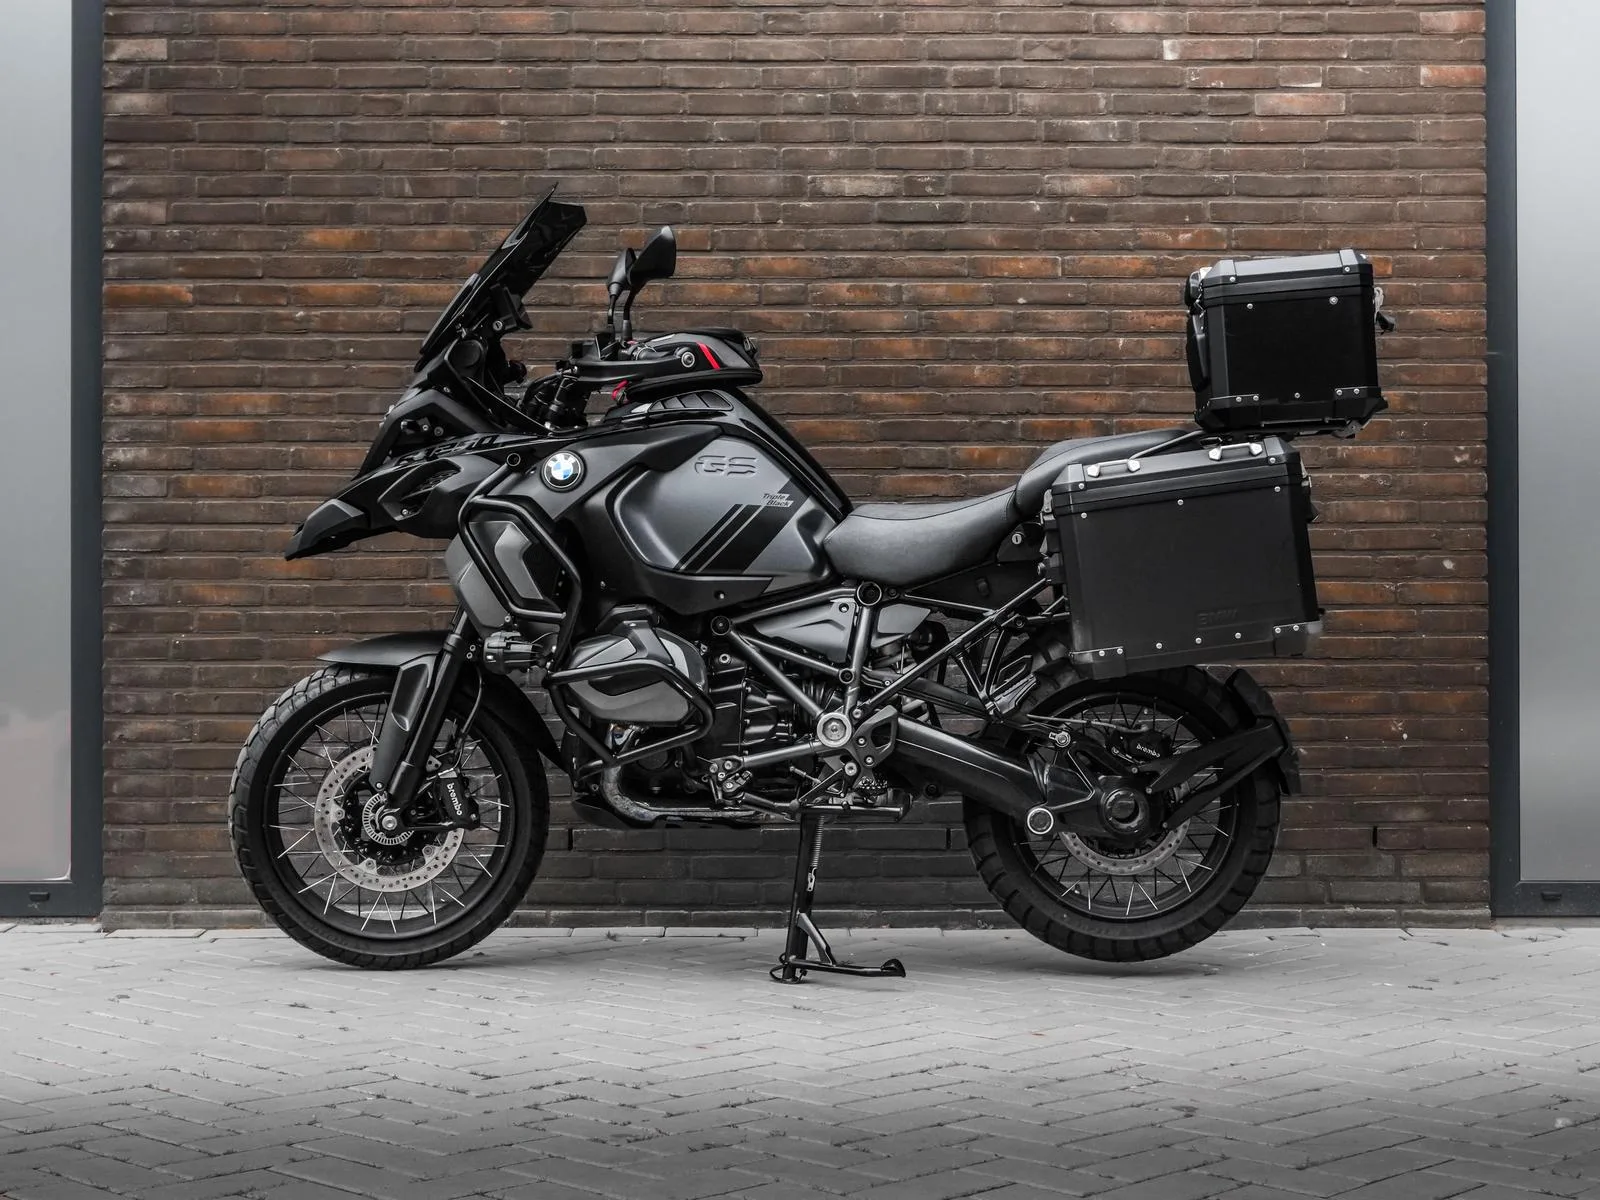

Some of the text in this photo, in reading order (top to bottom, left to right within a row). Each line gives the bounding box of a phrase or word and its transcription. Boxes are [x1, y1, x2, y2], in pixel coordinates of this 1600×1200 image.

[694, 454, 757, 477] GS
[762, 493, 787, 502] Triple
[1136, 743, 1161, 758] brembo
[446, 782, 463, 816] brembo
